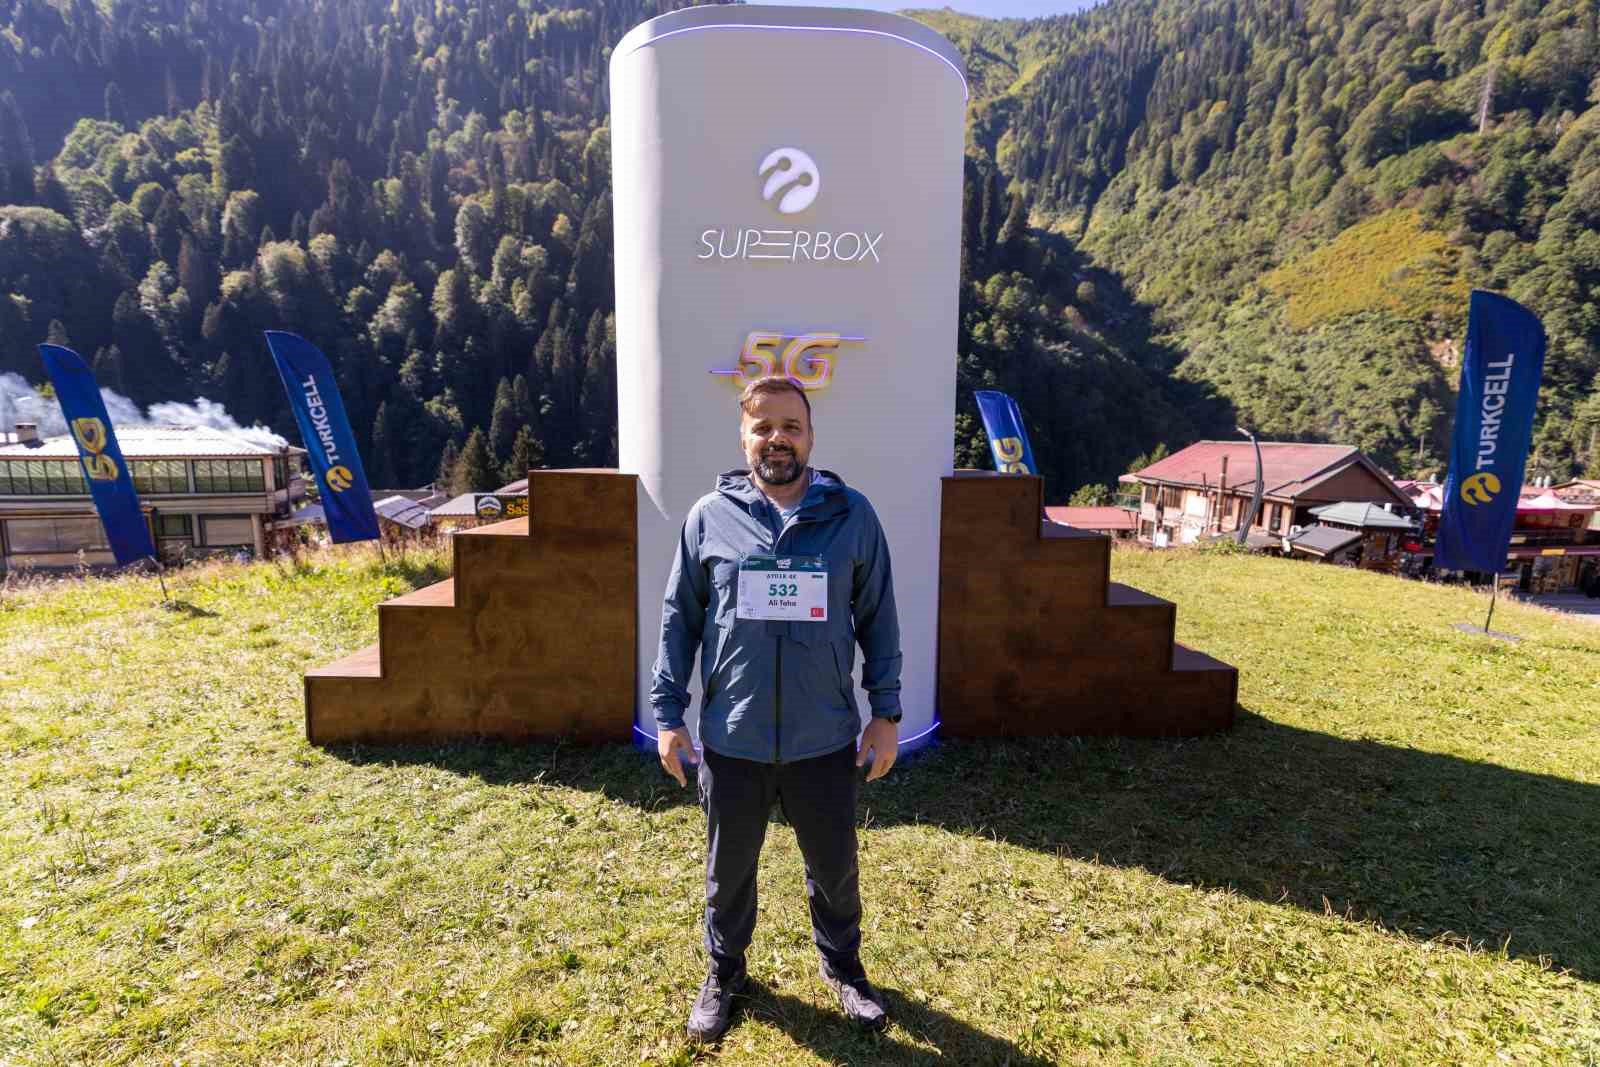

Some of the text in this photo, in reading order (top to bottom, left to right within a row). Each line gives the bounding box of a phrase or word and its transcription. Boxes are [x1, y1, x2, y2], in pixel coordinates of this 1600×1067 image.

[698, 227, 884, 263] SUPERBOX
[730, 331, 842, 392] 5G
[301, 374, 336, 465] TURKCELL
[1475, 352, 1515, 470] TURKCELL
[768, 584, 798, 597] 532
[768, 599, 778, 607] Ali
